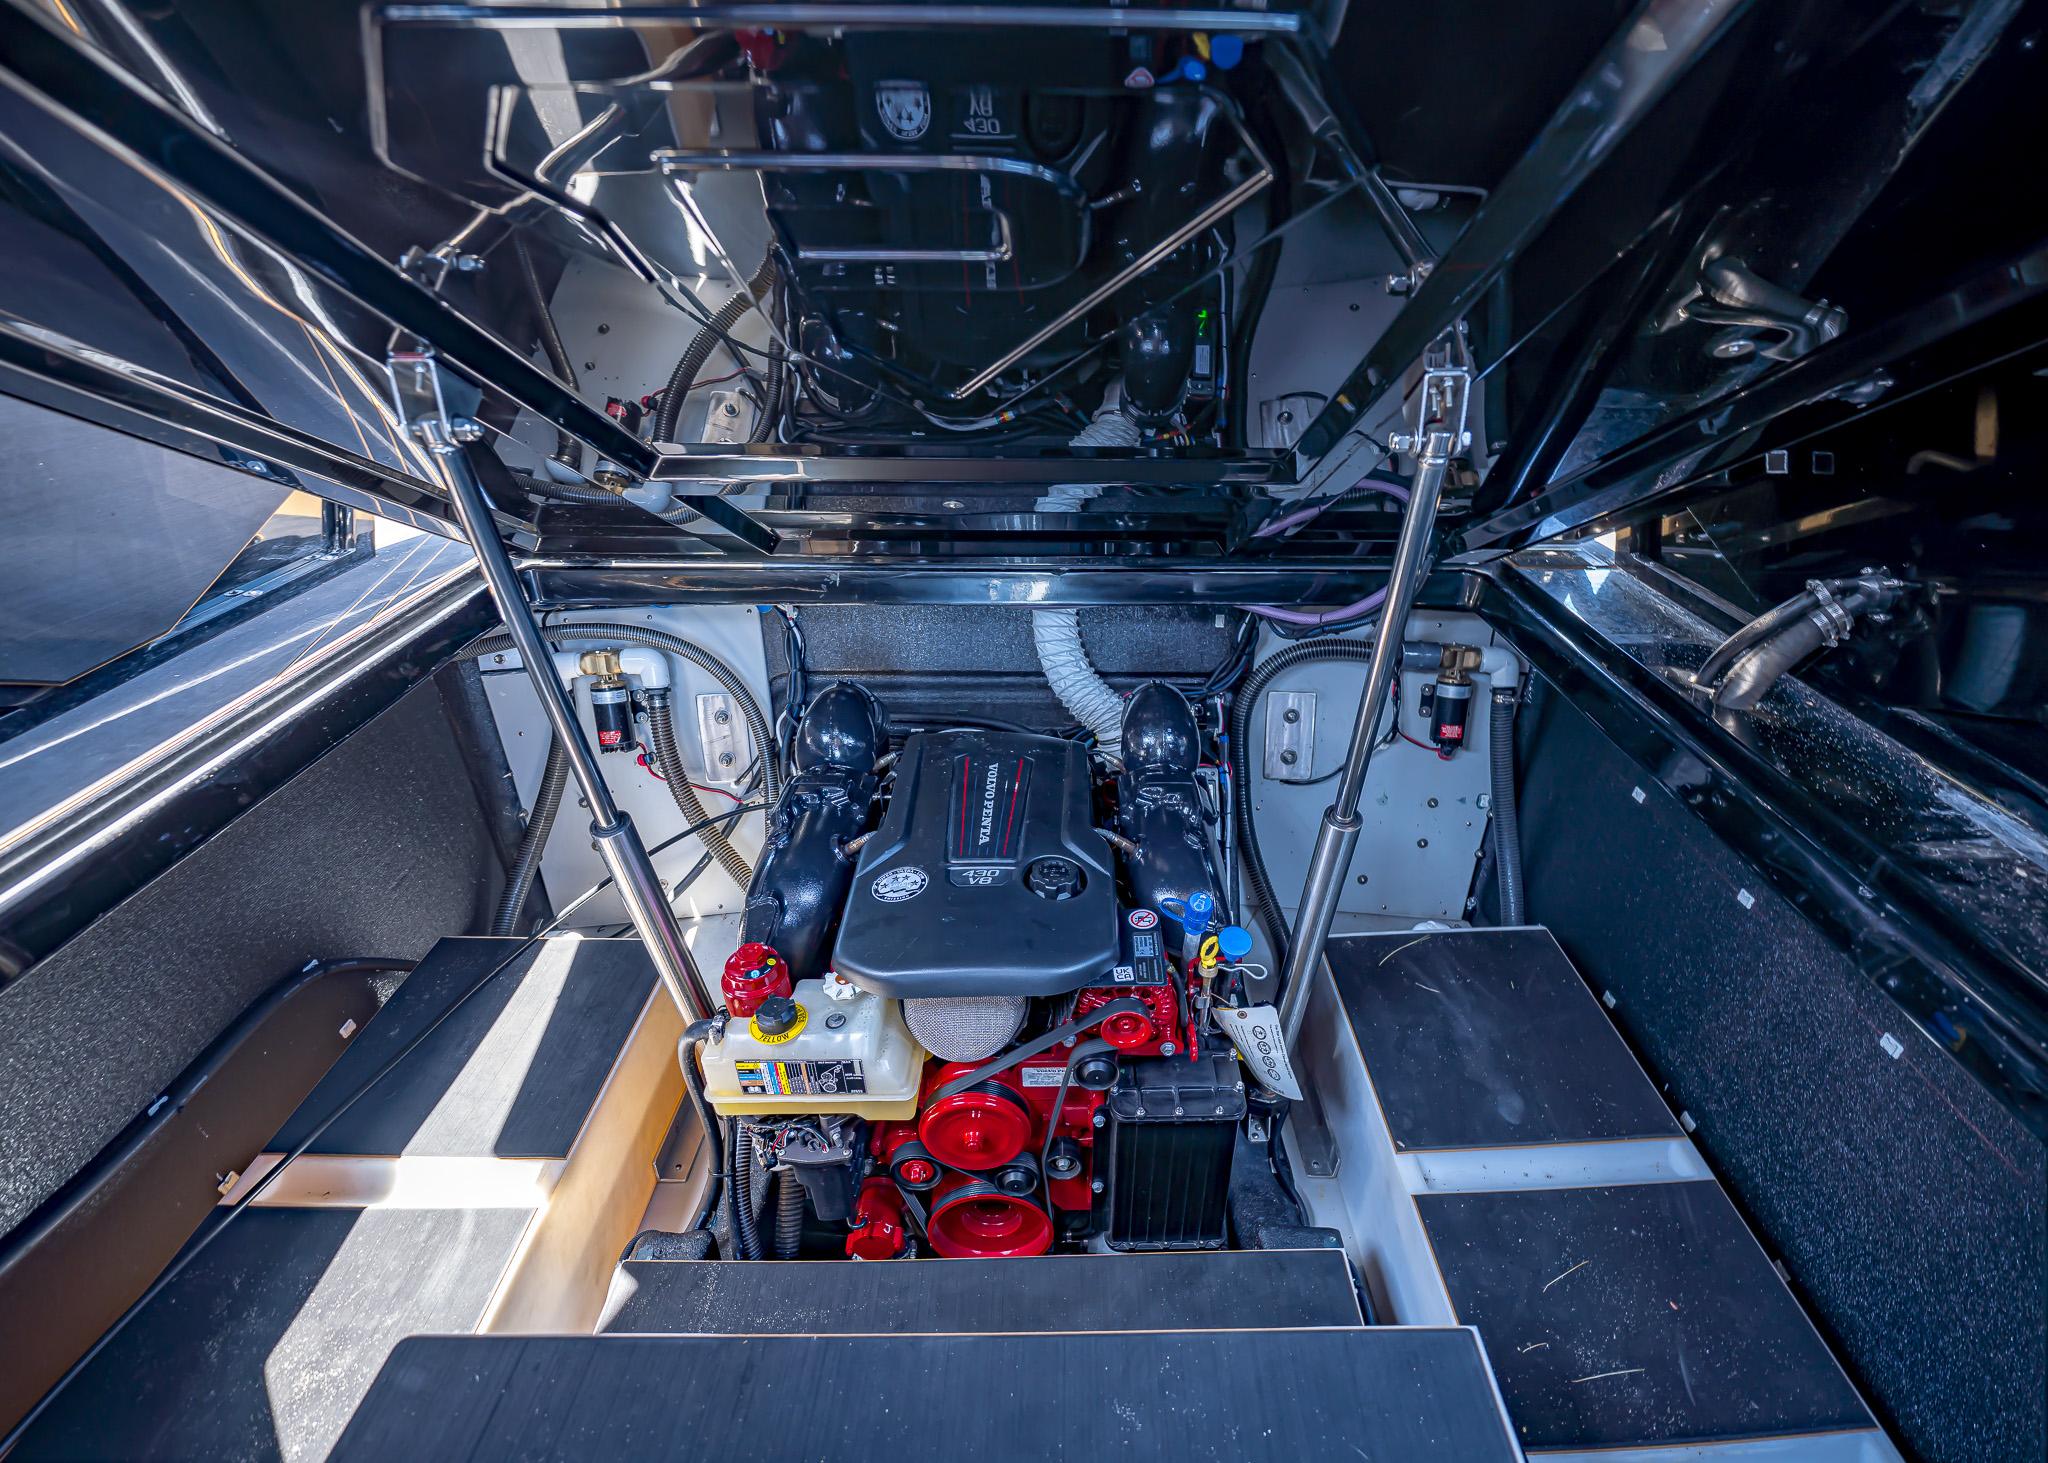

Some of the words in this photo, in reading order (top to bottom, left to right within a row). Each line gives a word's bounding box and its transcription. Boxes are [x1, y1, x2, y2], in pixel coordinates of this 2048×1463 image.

[984, 762, 998, 799] VOLVO
[978, 800, 994, 845] PENTA
[962, 869, 1000, 877] 430
[968, 876, 993, 885] V8
[759, 1032, 789, 1043] YELLOW
